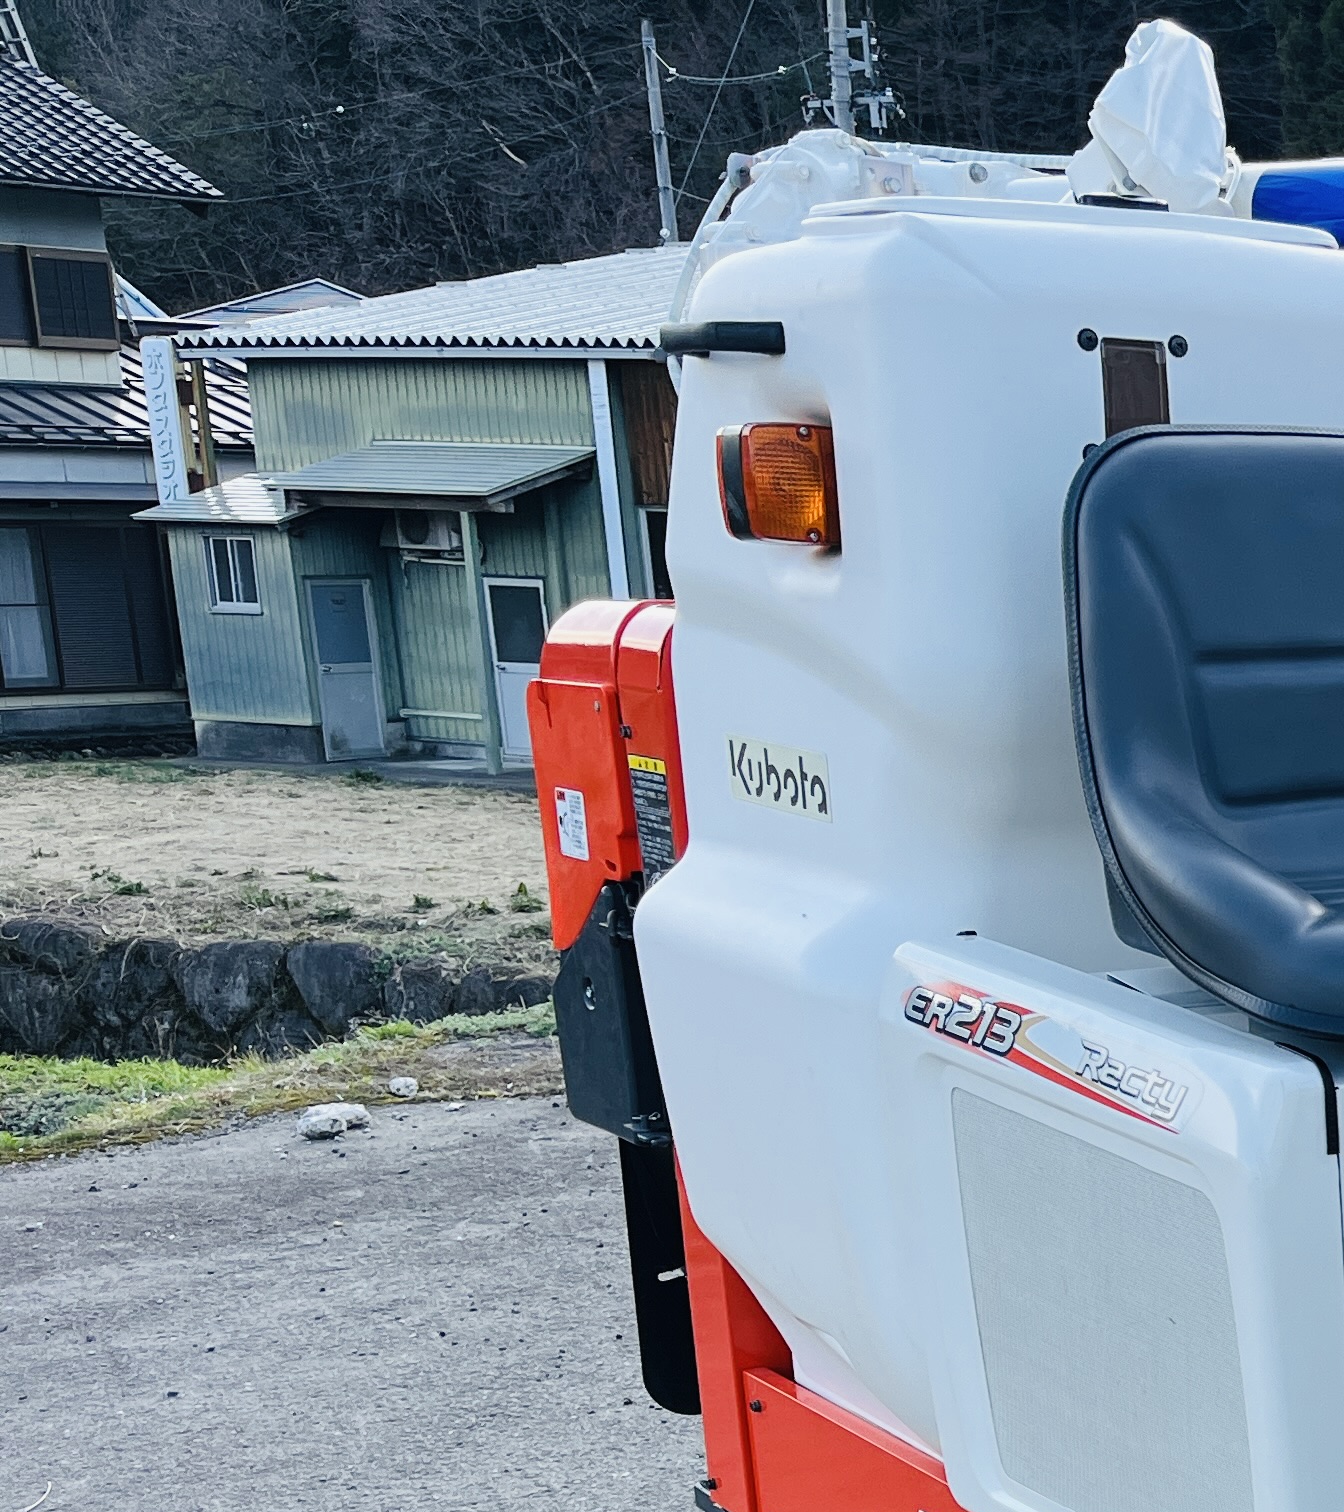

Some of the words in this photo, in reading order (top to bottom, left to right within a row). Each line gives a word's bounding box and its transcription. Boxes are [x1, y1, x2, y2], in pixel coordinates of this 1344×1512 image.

[728, 739, 828, 815] Kubota
[904, 985, 1022, 1057] ER213
[1074, 1037, 1190, 1123] Racty
